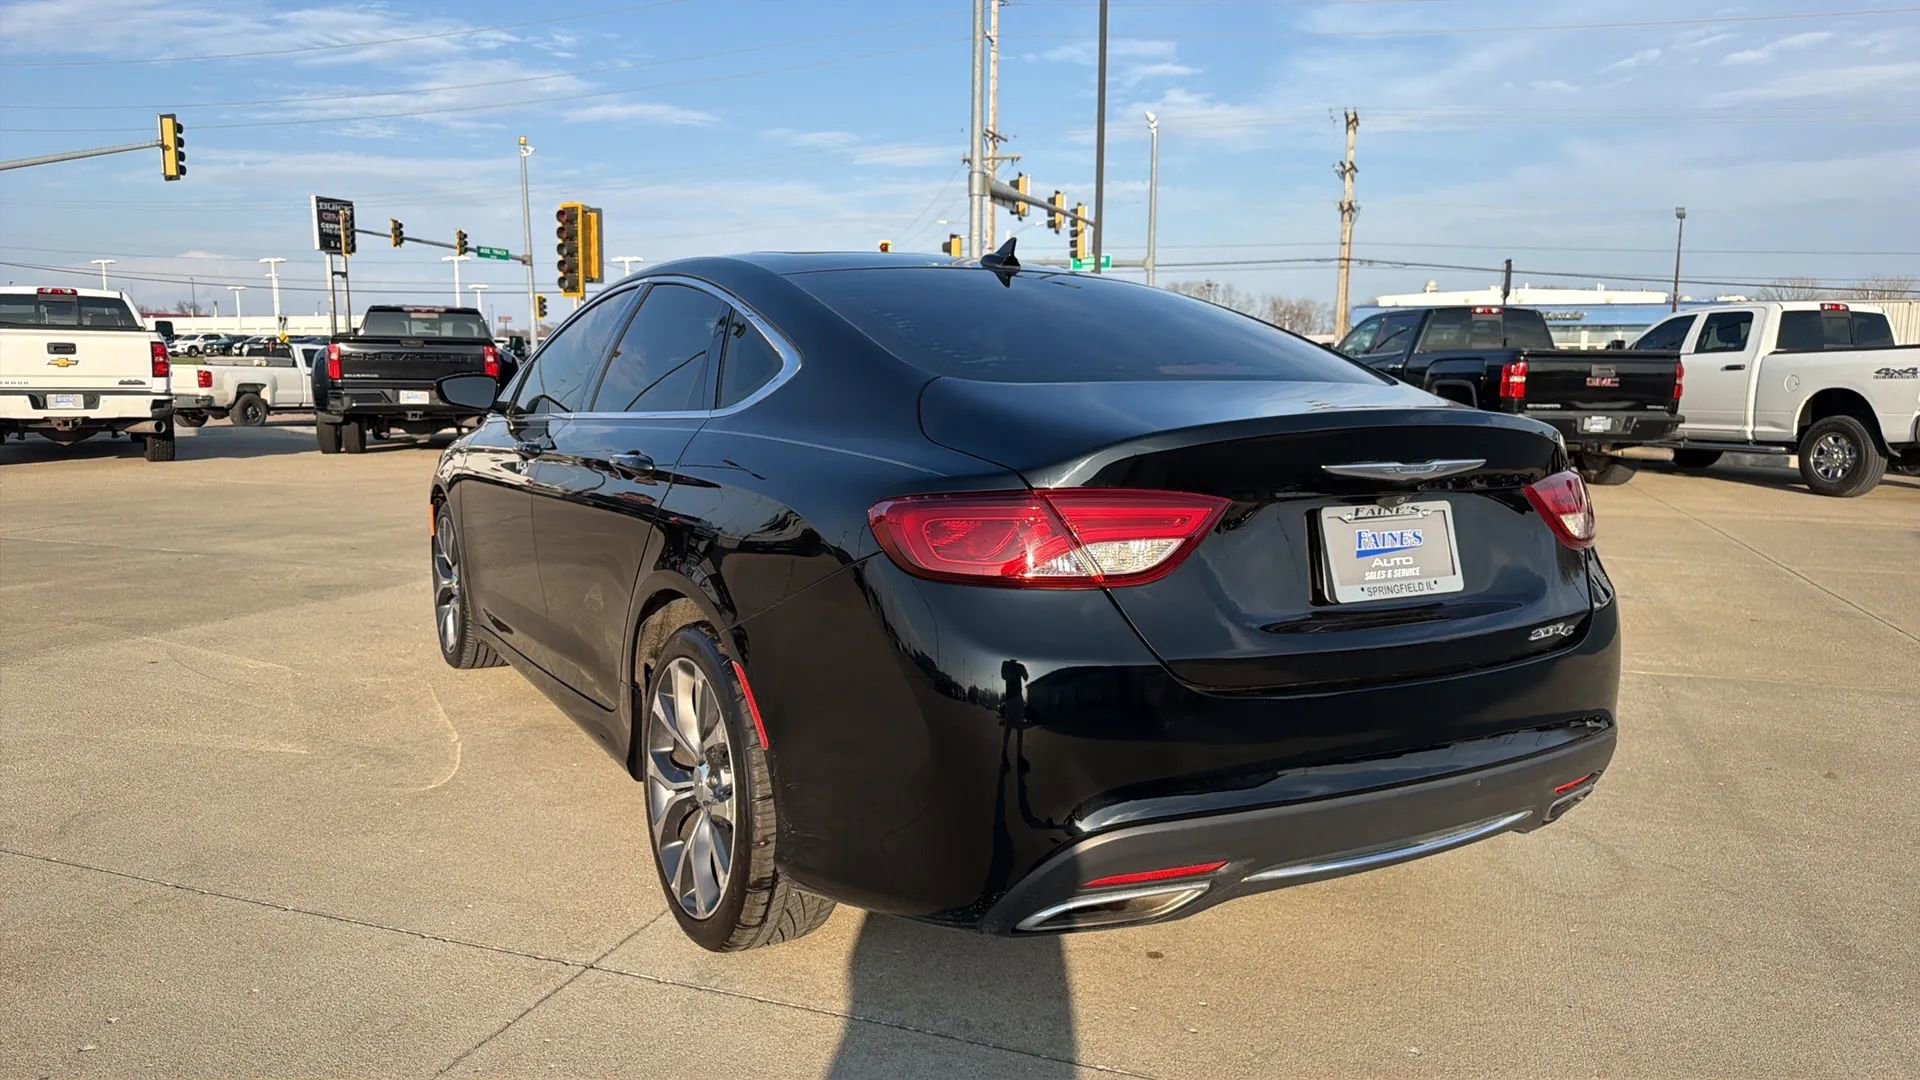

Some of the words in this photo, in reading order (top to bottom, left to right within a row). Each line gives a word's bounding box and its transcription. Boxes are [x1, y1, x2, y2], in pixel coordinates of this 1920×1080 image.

[1354, 505, 1420, 516] FAINE'S
[1356, 529, 1423, 550] FAINE'S
[1371, 556, 1414, 568] AUTO
[1364, 570, 1386, 580] SALES
[1393, 566, 1421, 578] SERVICE
[1366, 582, 1425, 597] SPRINGFIELD
[1425, 580, 1435, 591] IL
